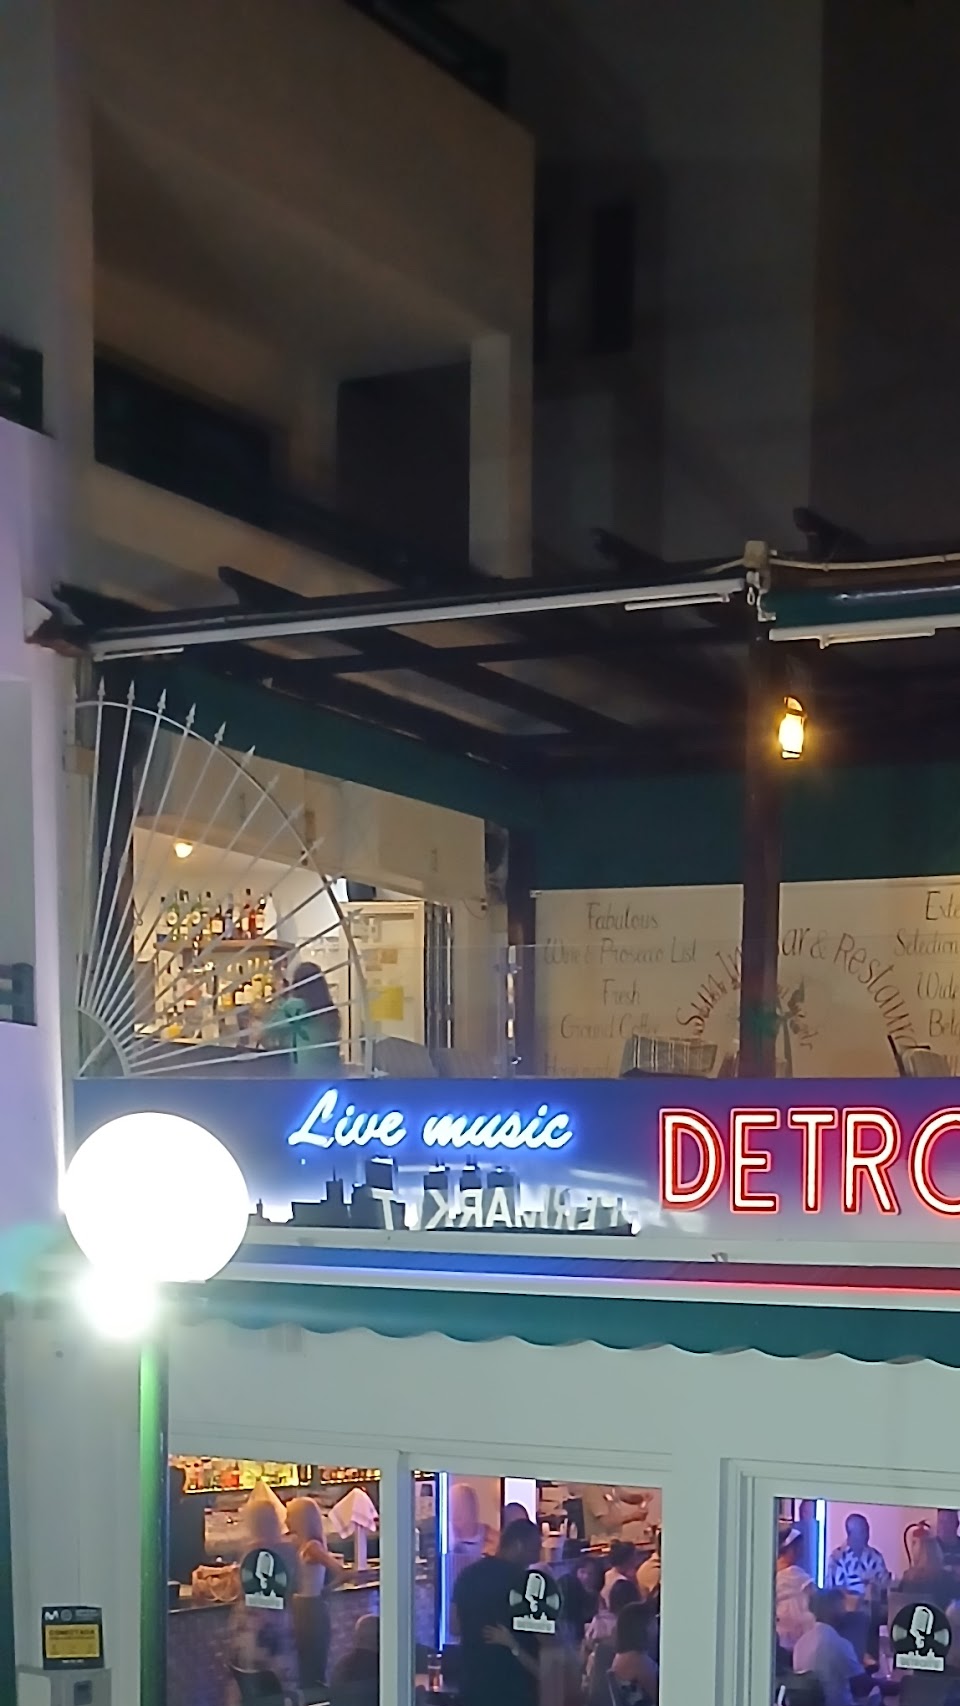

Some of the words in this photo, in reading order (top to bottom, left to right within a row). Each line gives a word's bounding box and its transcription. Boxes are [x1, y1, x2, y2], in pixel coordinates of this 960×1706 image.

[586, 902, 659, 931] Fabulous
[670, 936, 697, 964] List
[894, 928, 959, 957] Selection
[602, 977, 641, 1006] Fresh
[287, 1088, 407, 1149] Live
[422, 1104, 573, 1149] music
